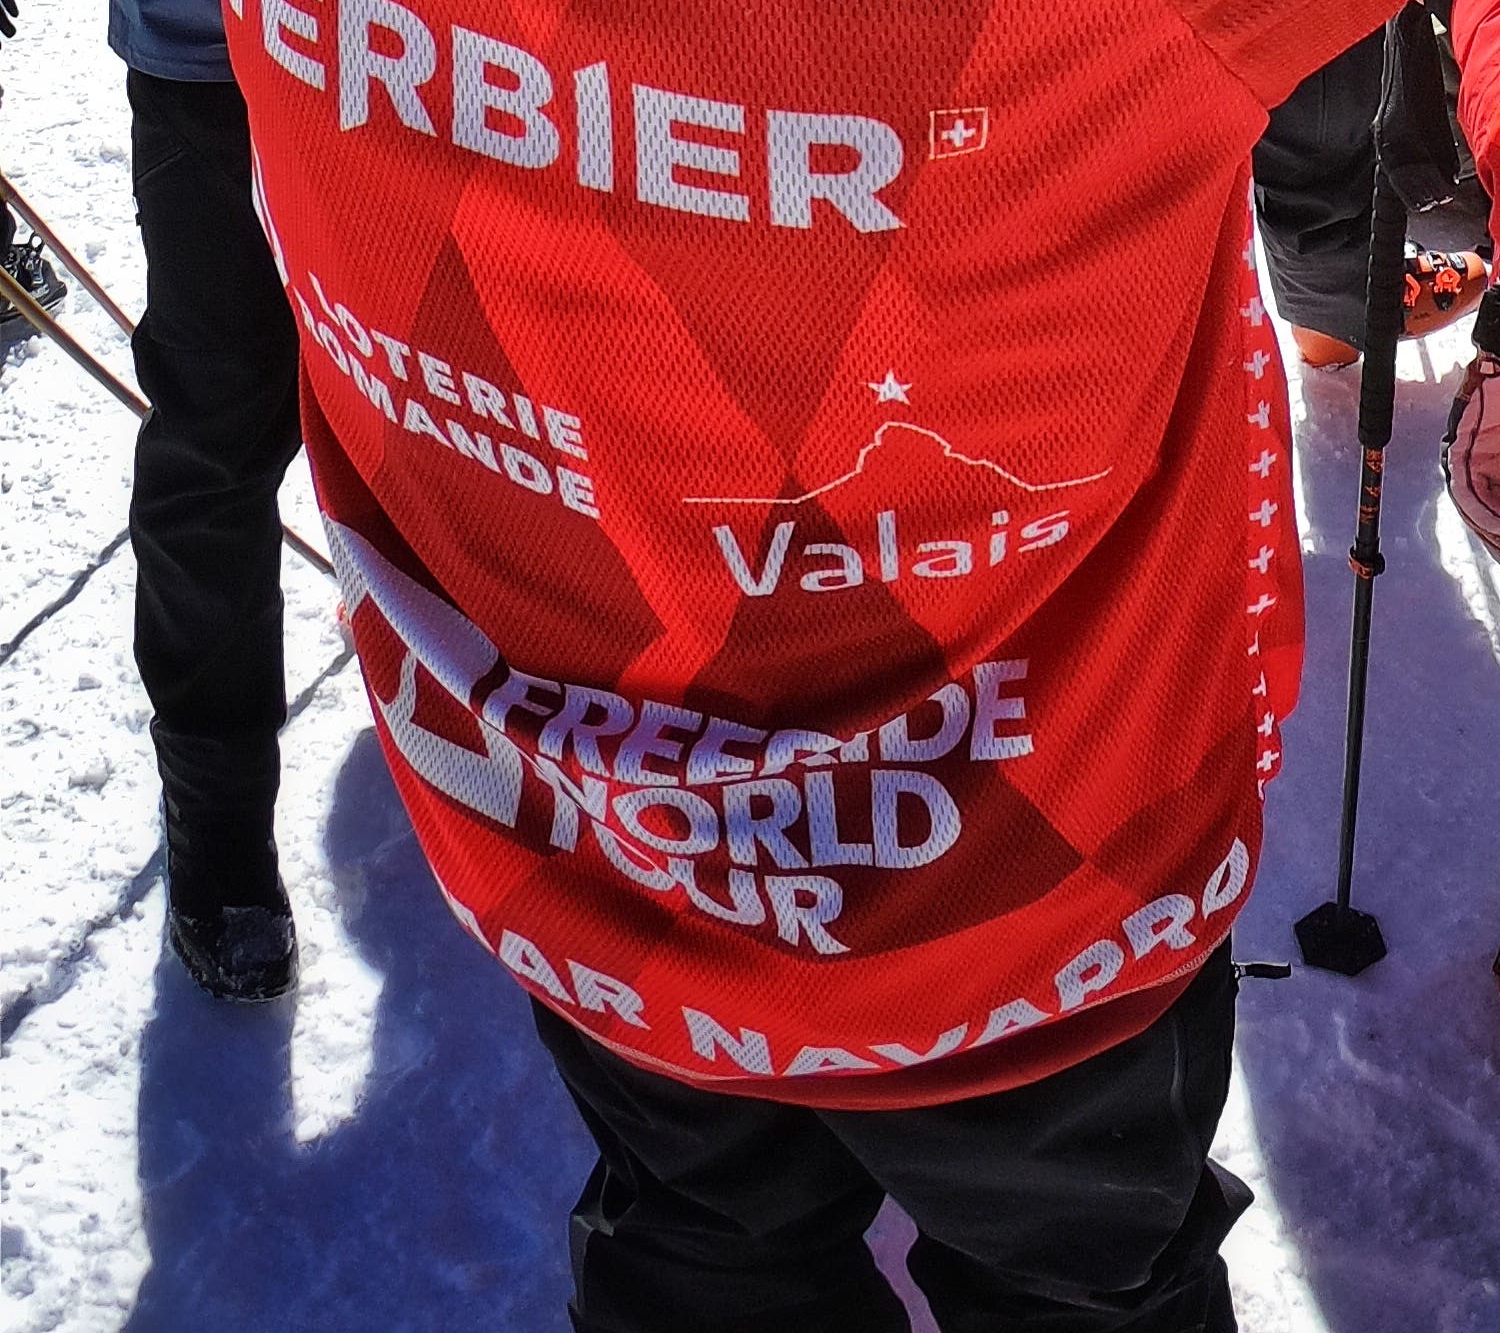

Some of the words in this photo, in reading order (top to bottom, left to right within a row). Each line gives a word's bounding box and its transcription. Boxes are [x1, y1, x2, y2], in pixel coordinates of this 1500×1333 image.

[293, 285, 601, 520] ROMANDE
[308, 270, 589, 462] LOTERIE
[712, 509, 1071, 597] Valais
